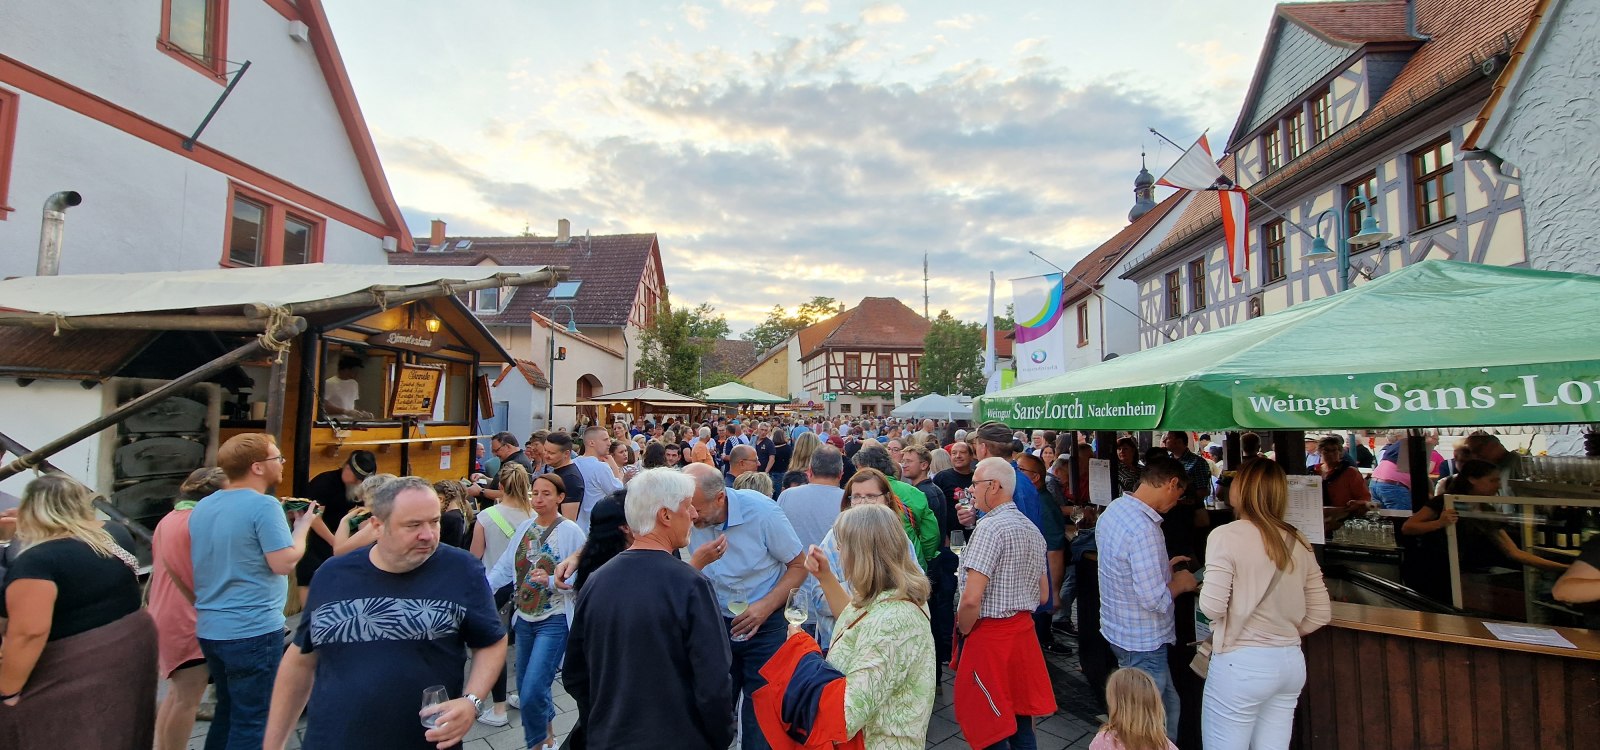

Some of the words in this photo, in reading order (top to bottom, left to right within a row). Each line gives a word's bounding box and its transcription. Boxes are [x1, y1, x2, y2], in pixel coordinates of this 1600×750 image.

[987, 408, 1011, 421] Weingut
[1013, 398, 1083, 420] Sans-Lorch
[1088, 401, 1156, 417] Nackenheim
[1249, 393, 1359, 416] Weingut
